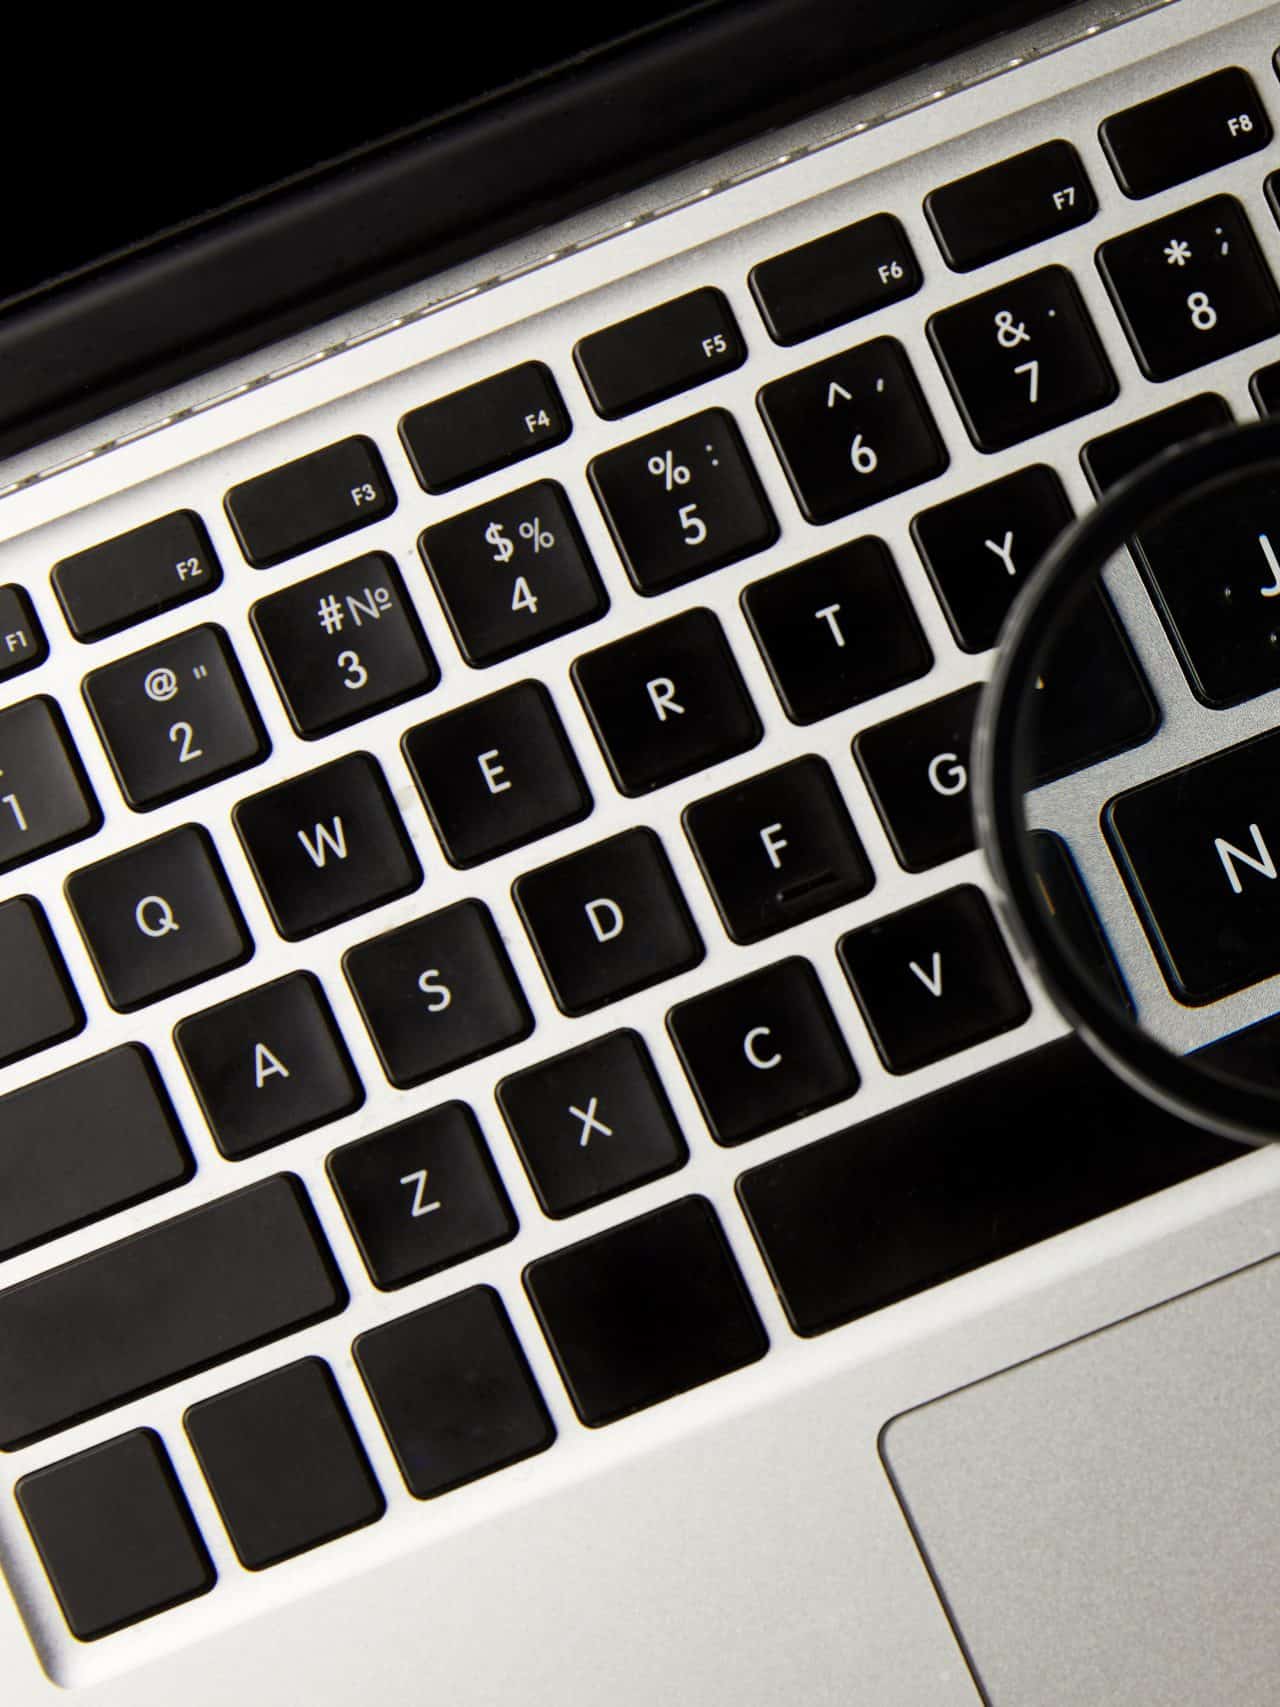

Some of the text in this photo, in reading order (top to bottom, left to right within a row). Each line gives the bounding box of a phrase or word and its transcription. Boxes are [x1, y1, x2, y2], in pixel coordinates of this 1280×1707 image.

[1227, 114, 1253, 137] F8
[1052, 186, 1075, 211] F7
[877, 261, 904, 284] F6
[994, 310, 1031, 348] &
[1187, 291, 1217, 331] 8
[701, 334, 727, 358] F5
[827, 381, 852, 408] ^
[1014, 360, 1039, 403] 7
[524, 409, 550, 433] F4
[647, 450, 691, 491] %
[850, 434, 878, 474] 6
[350, 483, 377, 507] F3
[678, 503, 707, 545] 5
[175, 557, 203, 581] F2
[984, 531, 1016, 575] Y
[511, 576, 538, 614] 4
[4, 630, 28, 653] F1
[814, 603, 845, 647] T
[144, 667, 179, 702] @
[337, 650, 368, 690] 3
[646, 677, 685, 722] R
[168, 721, 203, 763] 2
[477, 749, 512, 794] E
[928, 752, 967, 796] G
[1, 793, 28, 832] 1
[297, 815, 348, 868] W
[759, 823, 788, 869] F
[1214, 823, 1278, 894] N
[135, 895, 180, 938] Q
[584, 898, 624, 943] D
[418, 968, 452, 1012] S
[909, 951, 942, 997] V
[255, 1042, 290, 1089] A
[743, 1026, 782, 1069] C
[568, 1097, 613, 1147] X
[399, 1169, 441, 1217] Z
